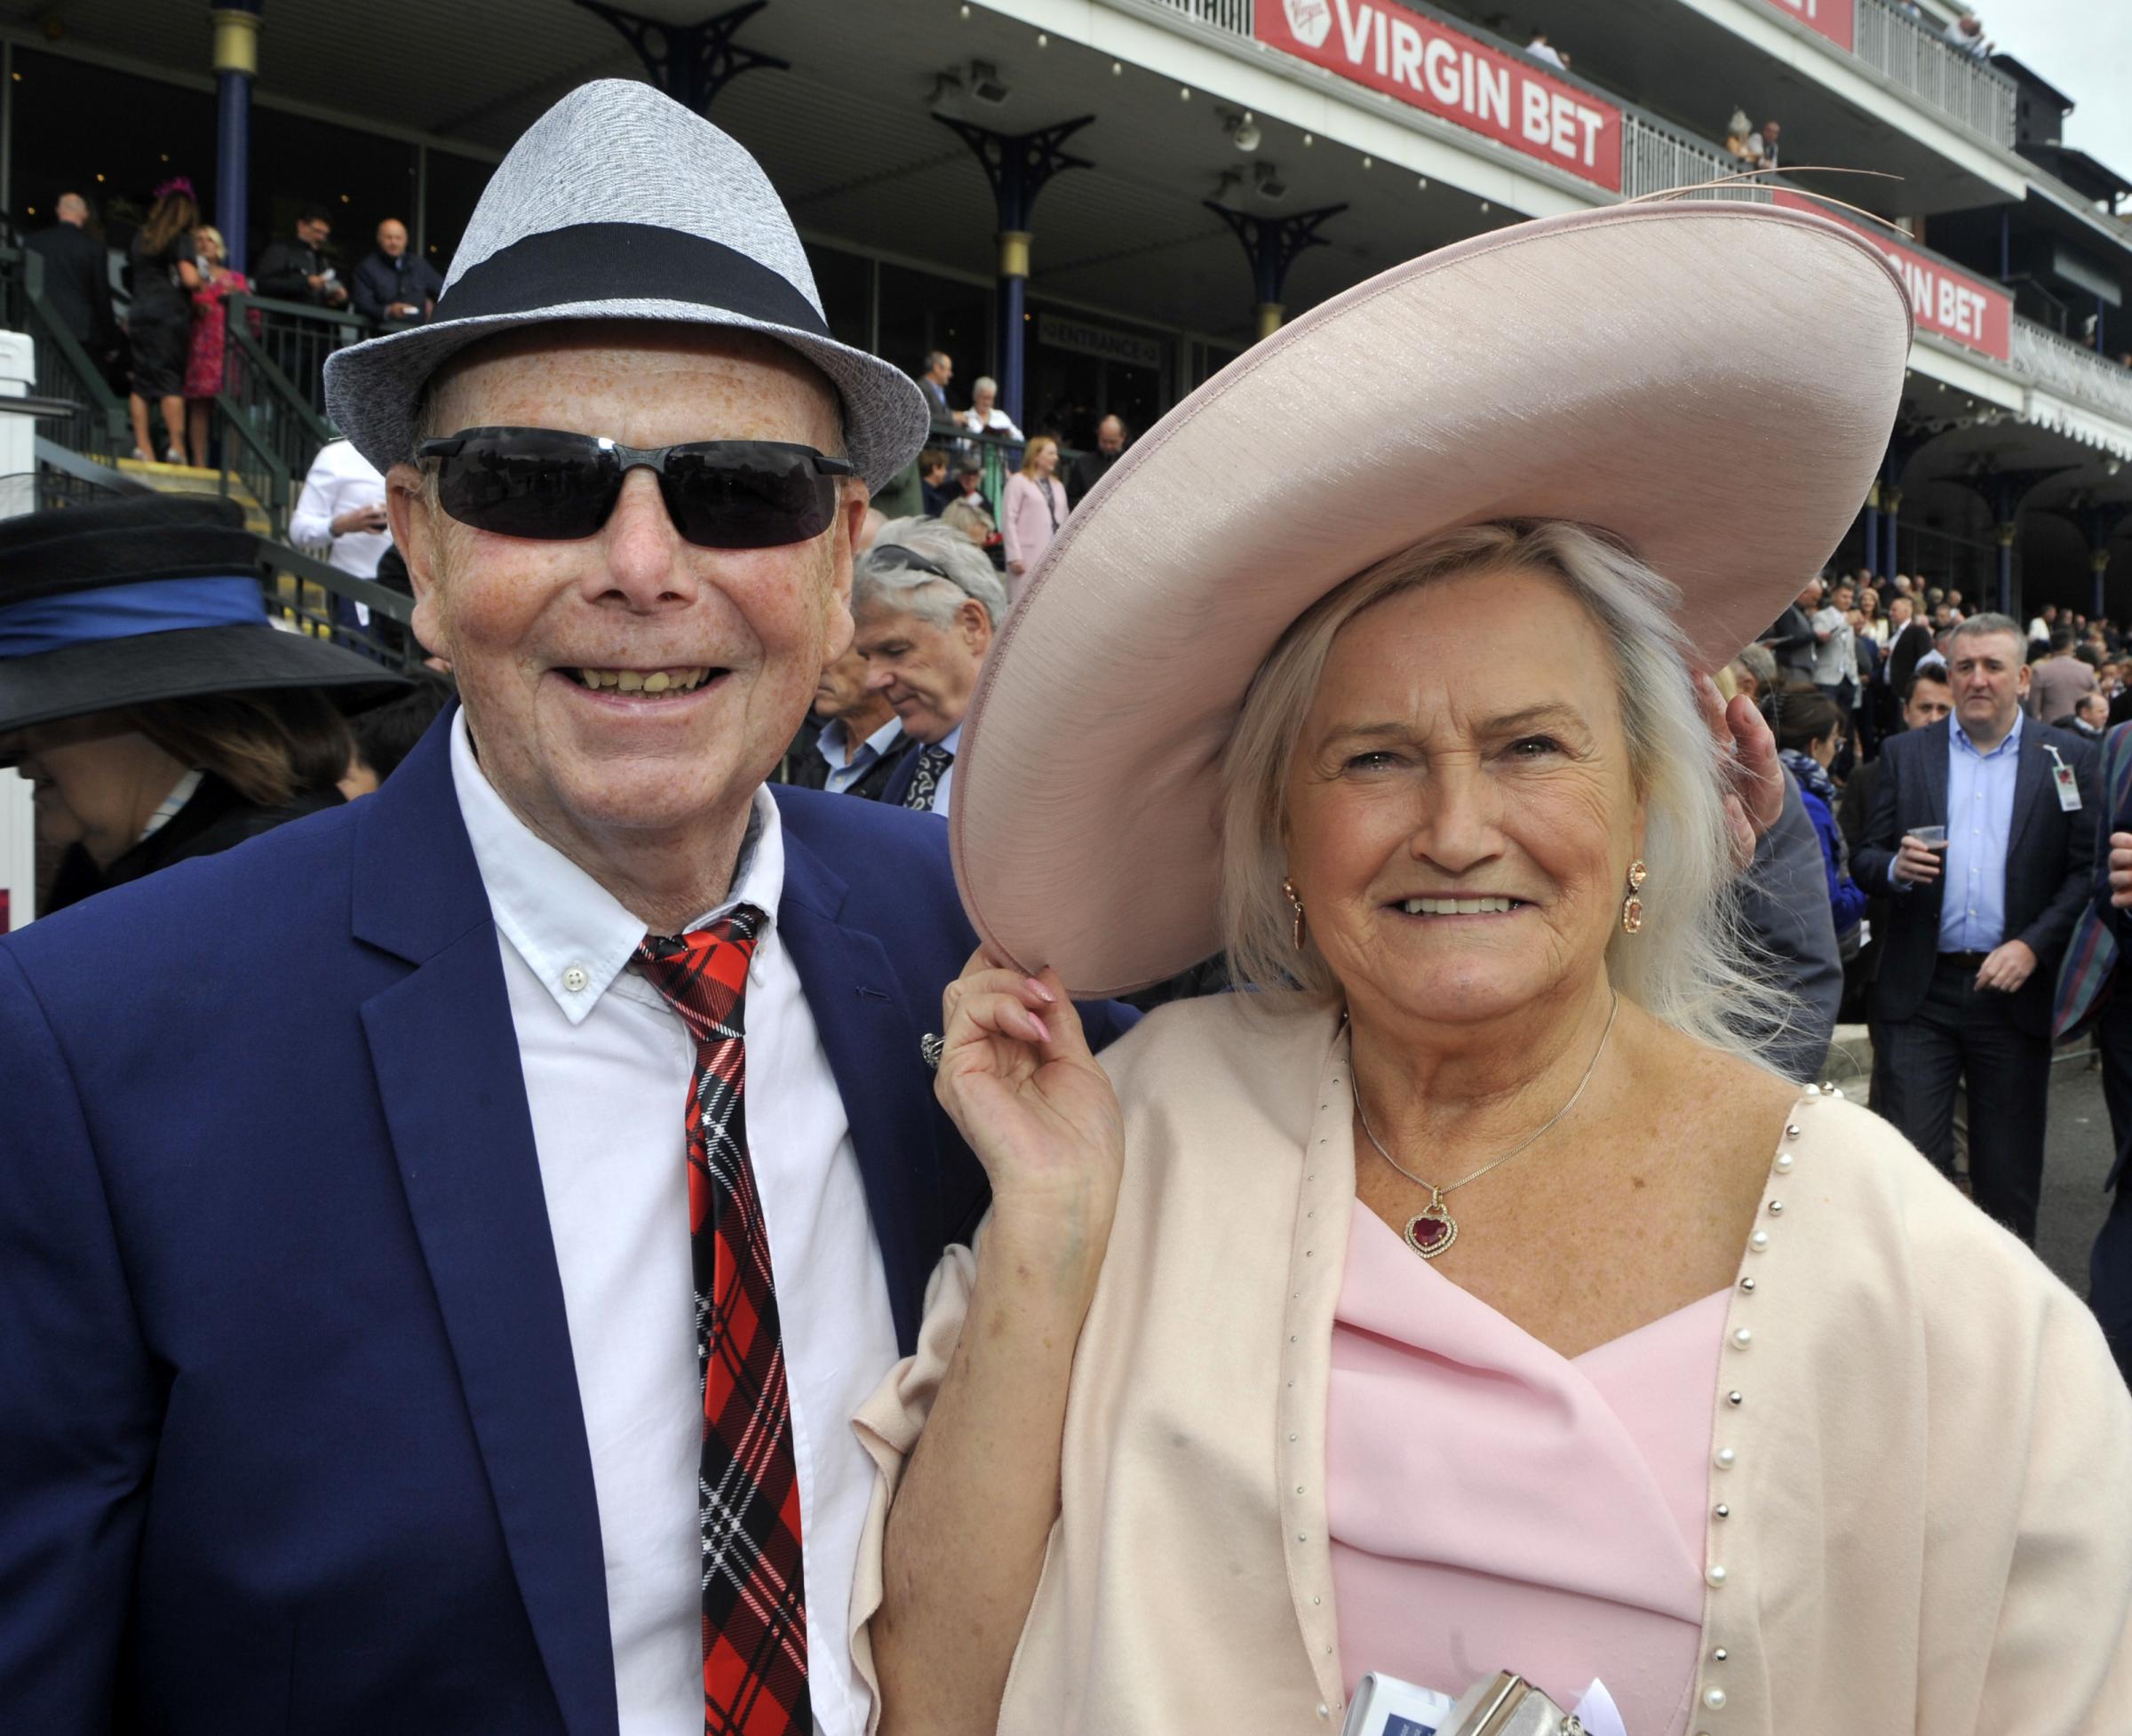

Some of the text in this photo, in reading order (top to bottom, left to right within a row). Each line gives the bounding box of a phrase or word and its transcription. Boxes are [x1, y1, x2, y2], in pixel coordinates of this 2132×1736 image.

[1336, 0, 1603, 167] VIRGIN BET
[1938, 277, 1986, 340] BET
[1057, 325, 1139, 359] ENTRANCE
